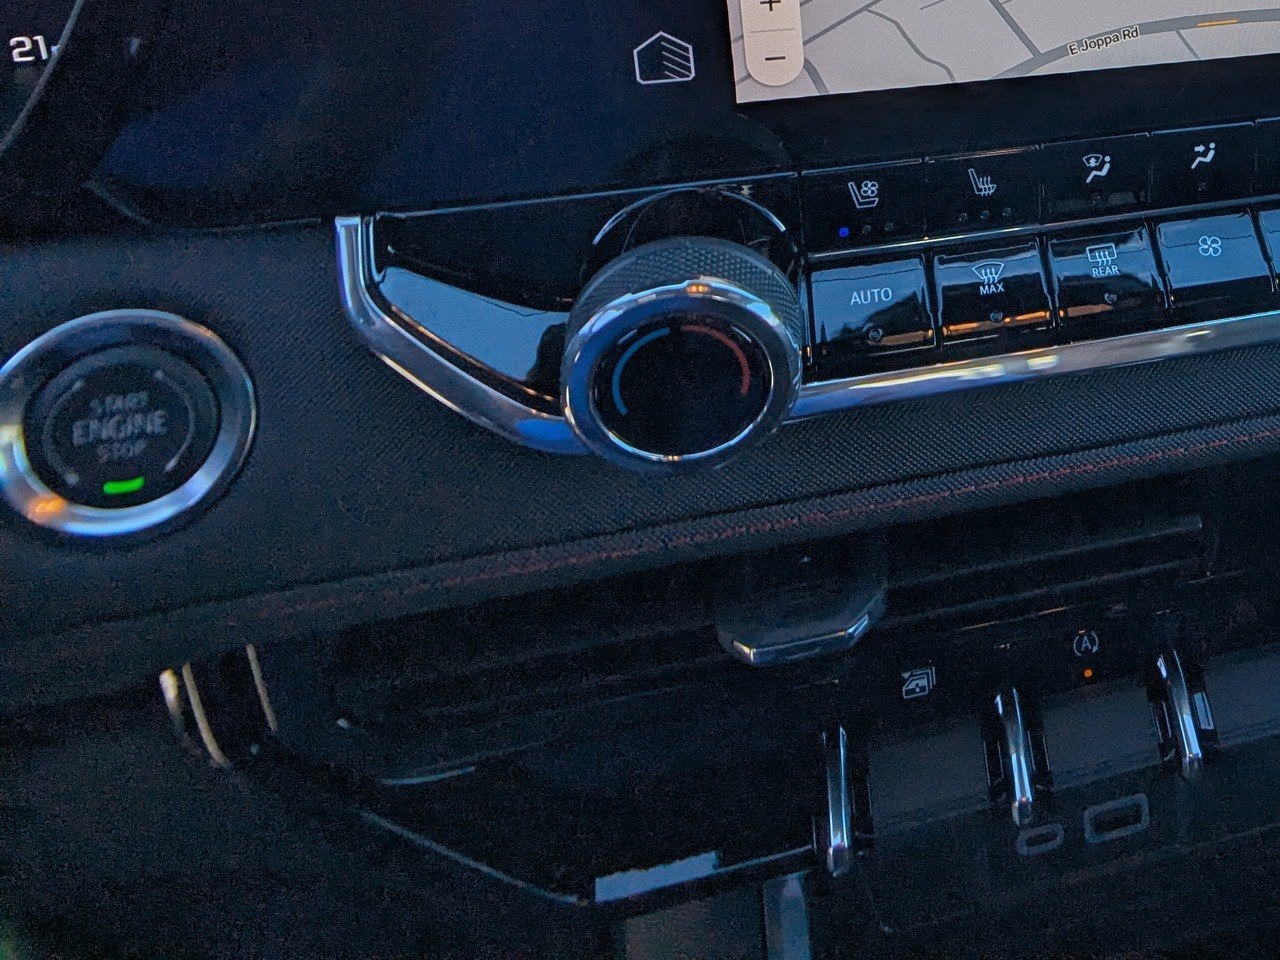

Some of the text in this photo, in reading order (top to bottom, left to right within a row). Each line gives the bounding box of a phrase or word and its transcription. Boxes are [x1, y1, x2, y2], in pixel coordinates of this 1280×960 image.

[9, 34, 48, 62] 21
[1069, 26, 1140, 56] E Joppa Rd
[1092, 264, 1120, 277] REAR
[850, 287, 892, 307] AUTO
[979, 282, 1005, 296] MAX
[72, 409, 169, 446] ENGINE
